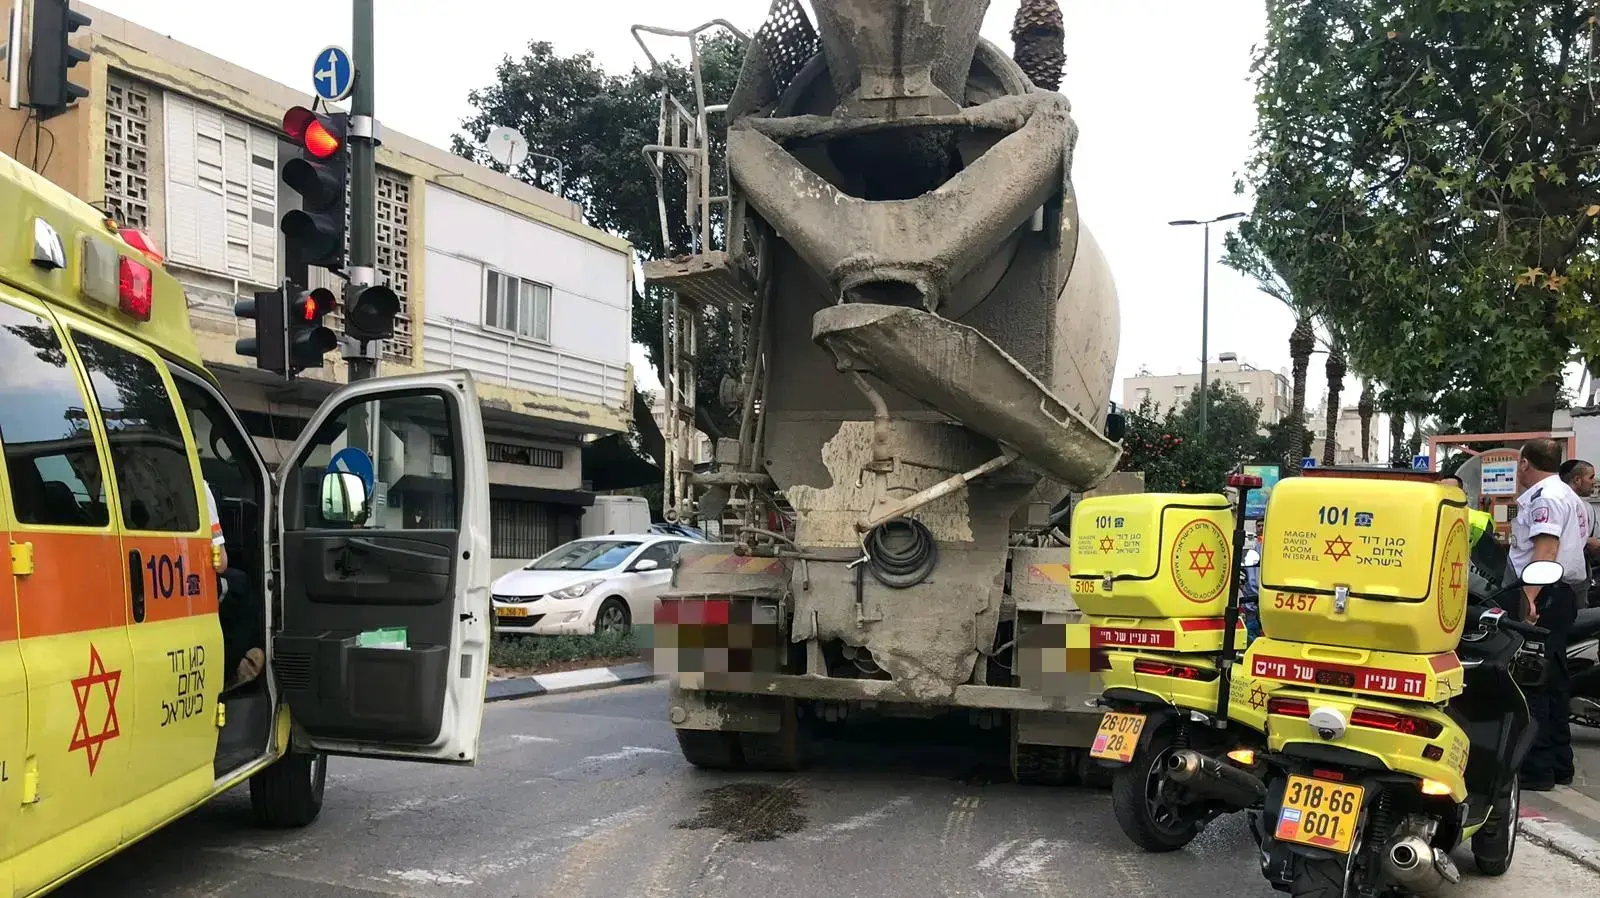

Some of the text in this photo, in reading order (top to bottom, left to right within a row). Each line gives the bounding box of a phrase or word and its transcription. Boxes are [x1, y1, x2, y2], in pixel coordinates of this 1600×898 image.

[1096, 516, 1112, 528] 101
[1319, 506, 1349, 526] 101
[1284, 531, 1317, 539] MAGEN
[1359, 535, 1406, 547] מגן דוד
[1283, 546, 1312, 554] ADOM
[1373, 547, 1404, 557] אדום
[1292, 554, 1320, 562] ISRAEL
[1356, 555, 1403, 568] בישראל
[147, 554, 184, 599] 101
[1076, 581, 1095, 593] 5105
[1275, 593, 1318, 611] 5457
[1115, 631, 1126, 641] של
[1130, 632, 1147, 644] עניין
[1151, 634, 1160, 644] זה
[167, 645, 205, 672] מגן דוד
[1293, 664, 1314, 680] של
[178, 668, 205, 697] אדום
[1365, 673, 1397, 691] עניין
[1404, 678, 1422, 694] זה
[161, 693, 203, 727] בישראל
[1107, 734, 1124, 751] 28
[1304, 811, 1340, 839] 601
